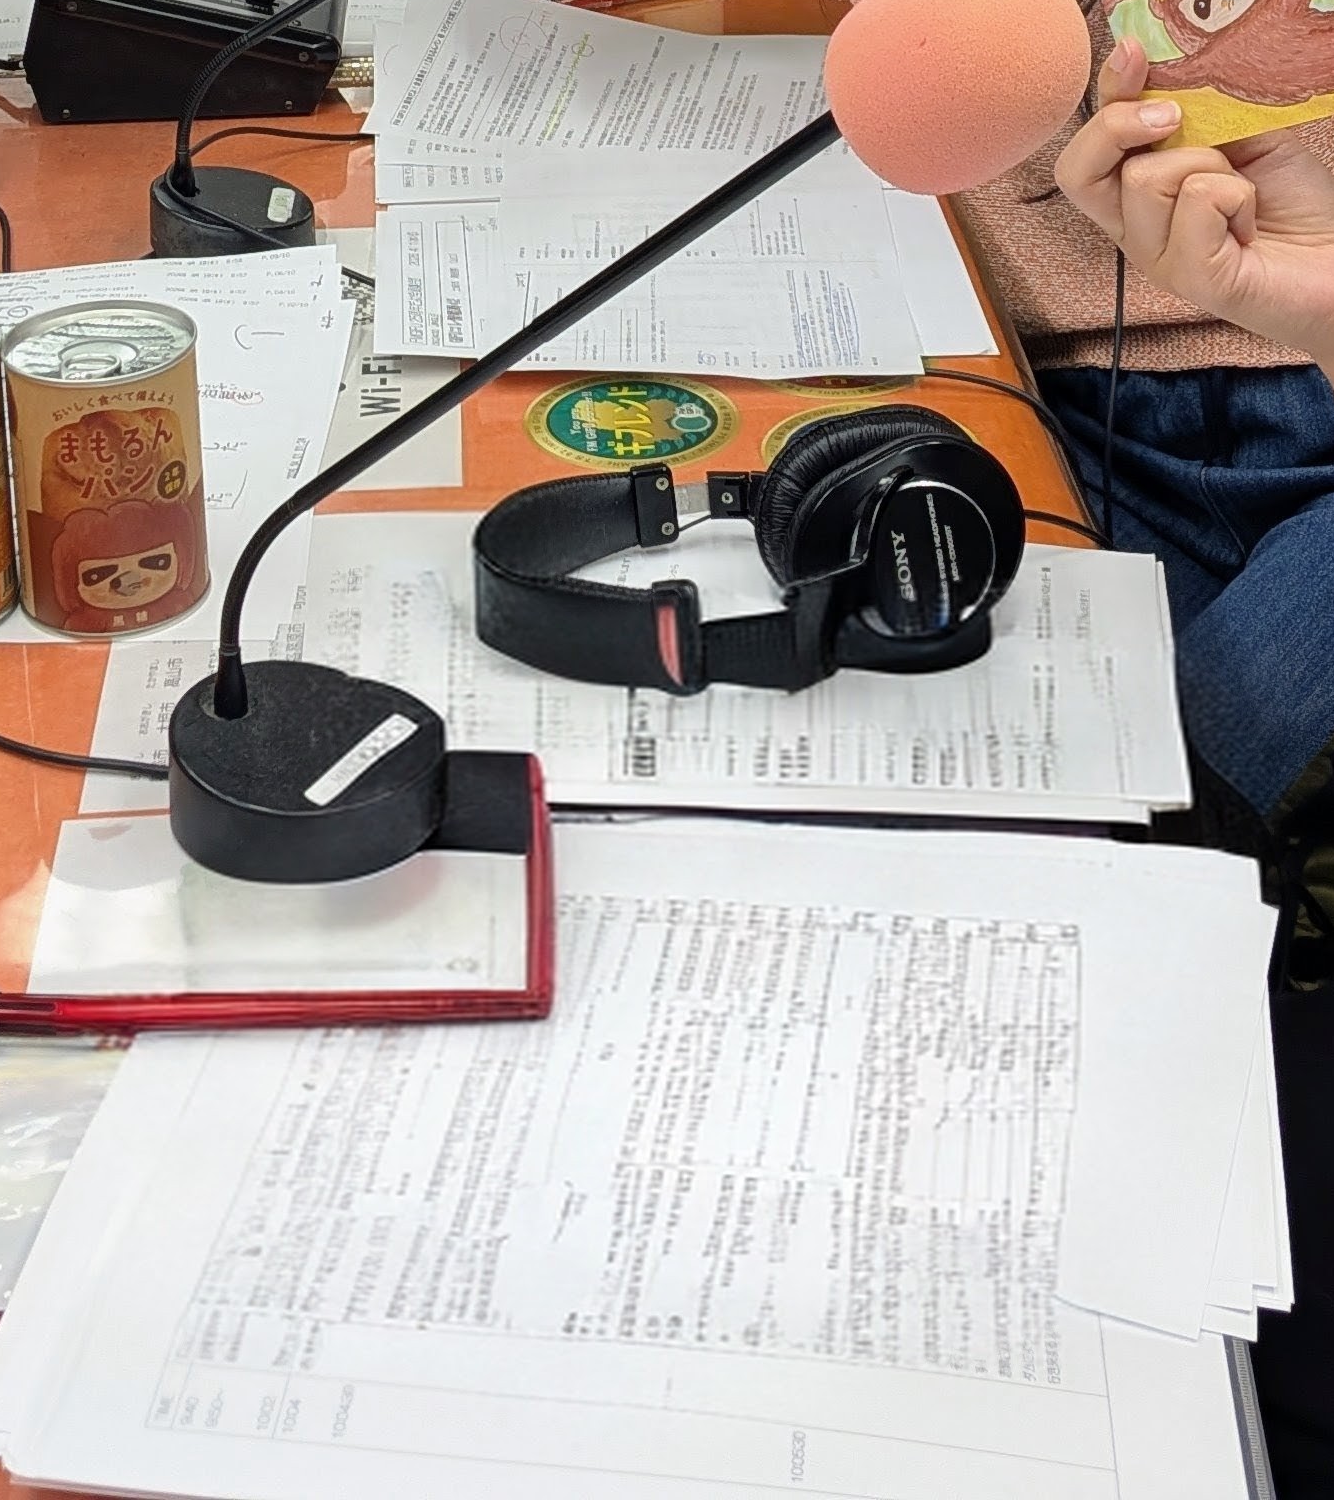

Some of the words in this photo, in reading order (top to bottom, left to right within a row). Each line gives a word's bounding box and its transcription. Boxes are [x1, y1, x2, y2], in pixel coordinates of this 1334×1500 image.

[52, 390, 177, 422] おいしく食べて備えよう
[607, 386, 656, 456] ギフレンド
[58, 417, 173, 465] まもるん
[79, 465, 155, 500] パン
[890, 529, 917, 603] SONY
[164, 657, 184, 688] 高山市
